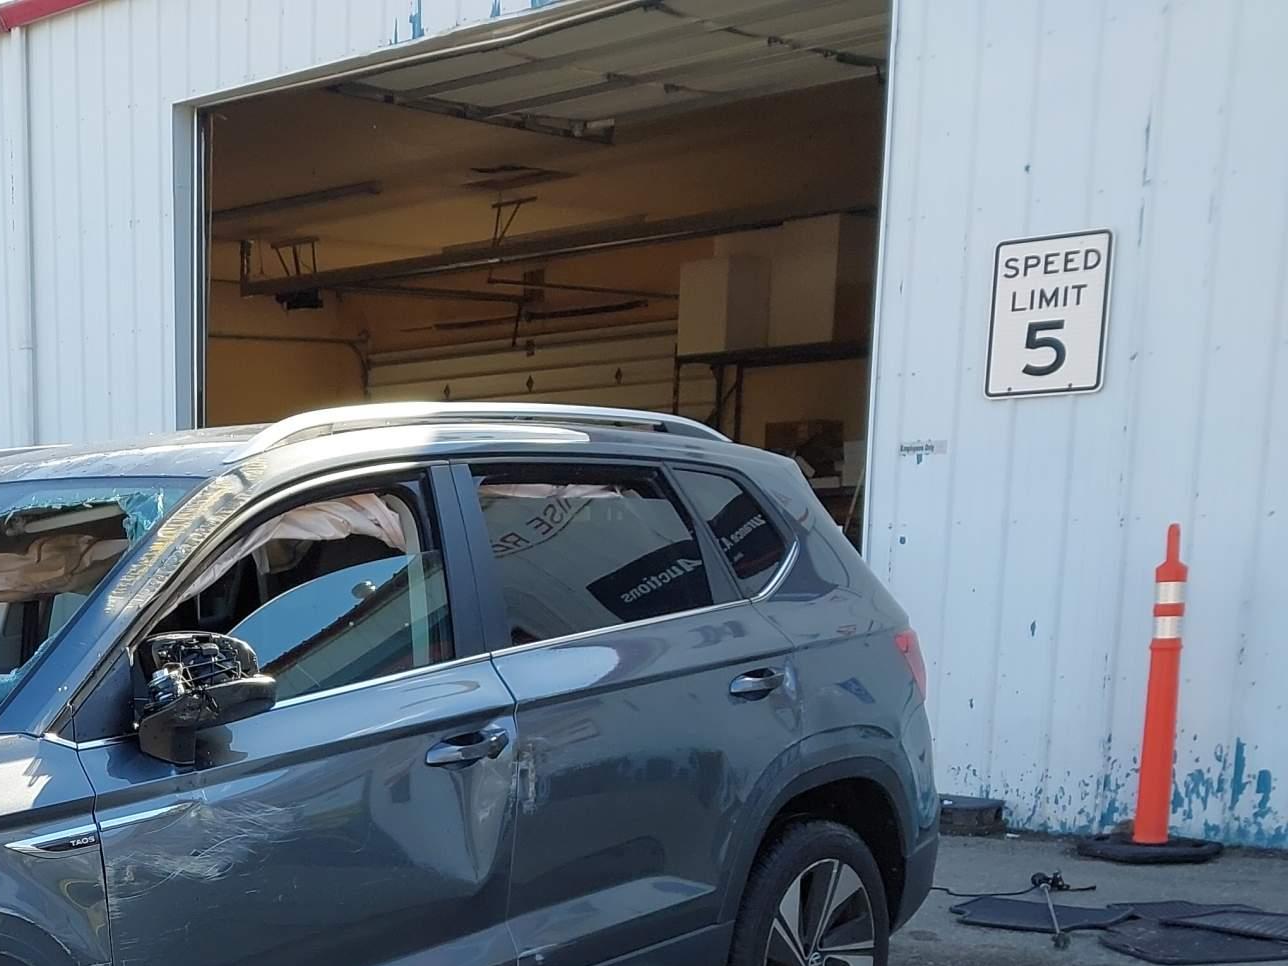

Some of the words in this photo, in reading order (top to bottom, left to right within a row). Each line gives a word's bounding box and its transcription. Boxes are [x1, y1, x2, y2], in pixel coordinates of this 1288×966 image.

[1003, 248, 1102, 279] SPEED
[1011, 283, 1088, 313] LIMIT
[1021, 318, 1067, 377] 5
[70, 835, 96, 847] TAOS
